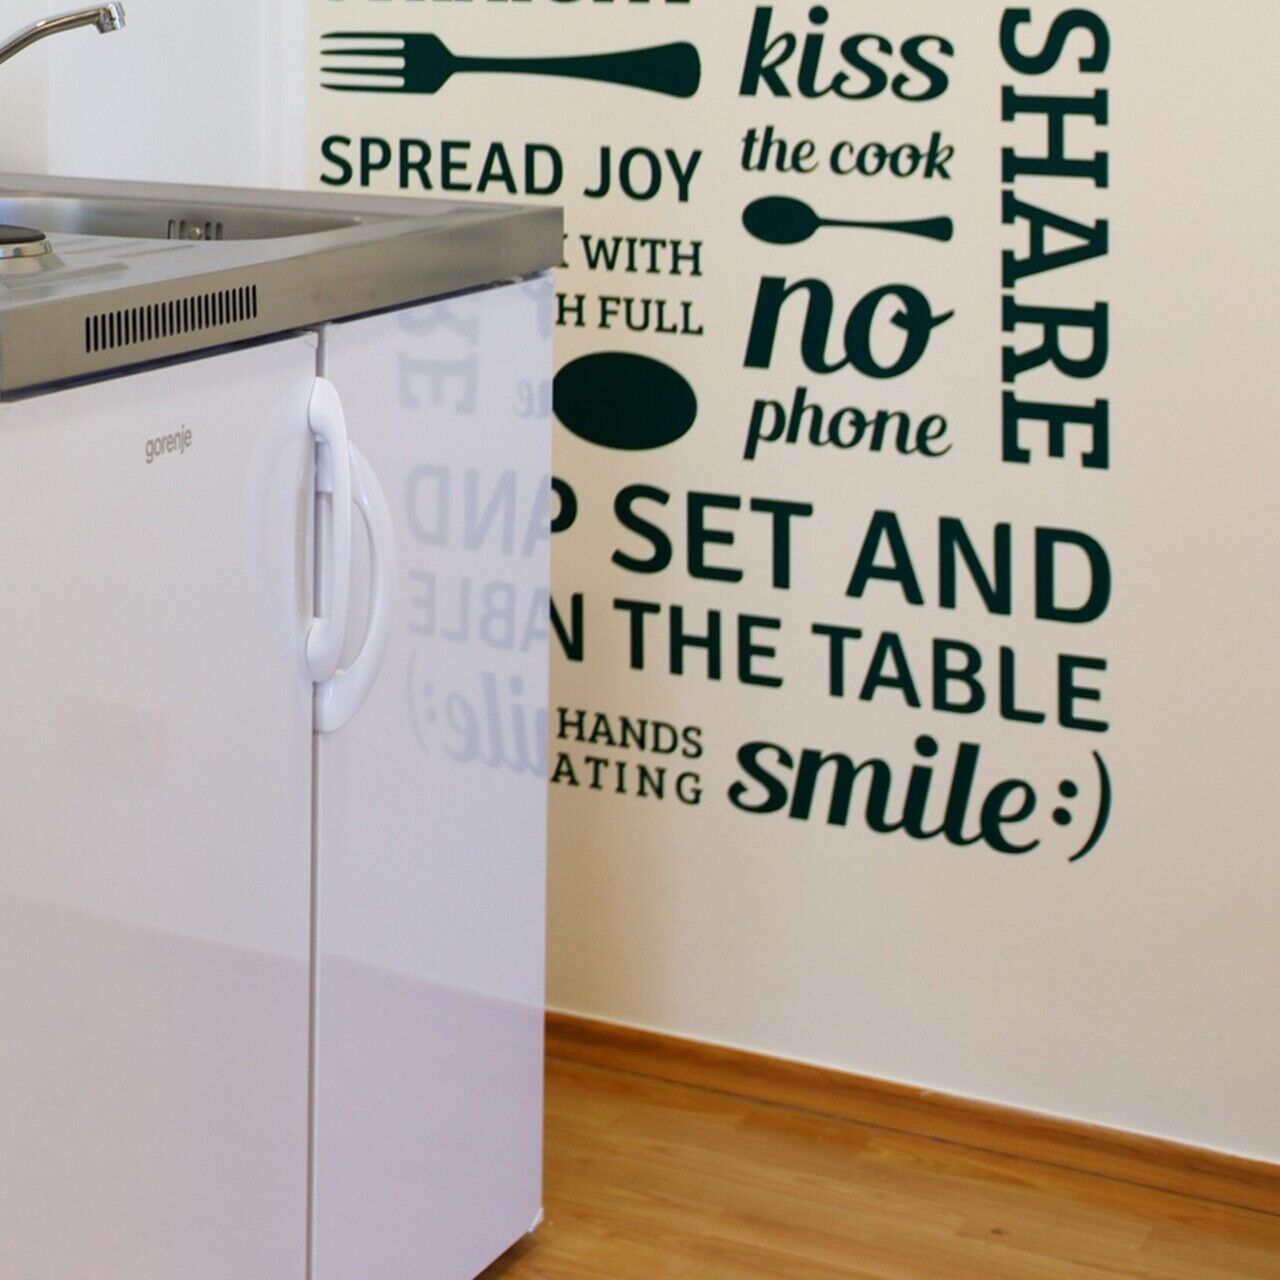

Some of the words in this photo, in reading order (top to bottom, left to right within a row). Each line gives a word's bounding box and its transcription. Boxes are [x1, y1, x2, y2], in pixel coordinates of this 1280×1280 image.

[738, 5, 955, 102] kiss
[319, 134, 564, 196] SPREAD
[583, 145, 703, 203] JOY
[741, 125, 817, 174] the
[829, 131, 955, 180] cook
[579, 234, 703, 277] WITH
[999, 7, 1111, 470] SHARE
[597, 295, 704, 336] FULL
[743, 275, 955, 380] no
[144, 423, 192, 465] gorenje
[742, 386, 952, 461] phone
[610, 483, 814, 590] SET
[845, 509, 1112, 625] AND
[612, 597, 784, 689] THE
[810, 622, 1110, 733] TABLE
[556, 706, 704, 760] HANDS
[549, 751, 703, 806] ATING
